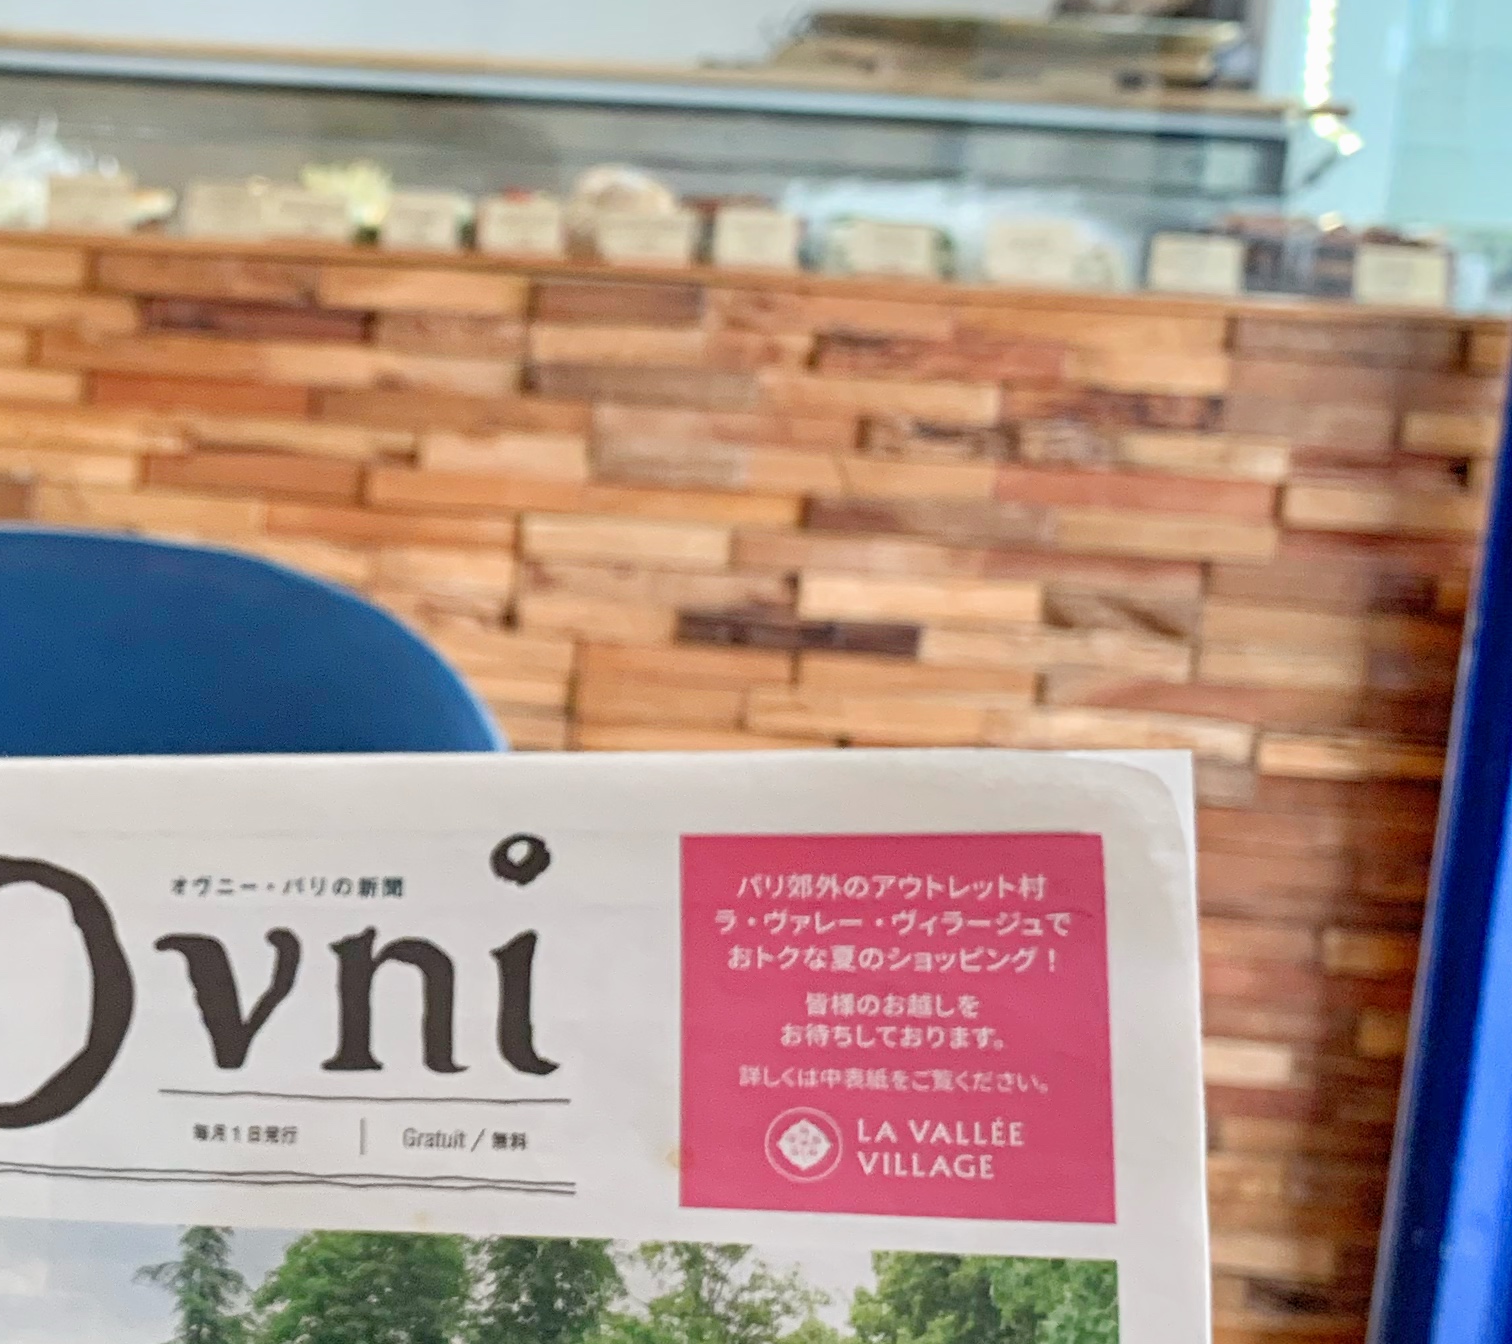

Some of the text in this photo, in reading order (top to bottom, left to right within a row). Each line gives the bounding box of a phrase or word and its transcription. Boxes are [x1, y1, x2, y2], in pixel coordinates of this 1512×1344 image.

[736, 873, 1047, 901] パリ郊外のアウトレット村
[804, 991, 981, 1019] 皆様のお越しを
[780, 1022, 1004, 1051] お待ちしております。
[402, 1127, 467, 1149] Gratuit
[857, 1116, 1026, 1147] LA VALLÉE
[856, 1151, 995, 1179] VILLAGE
